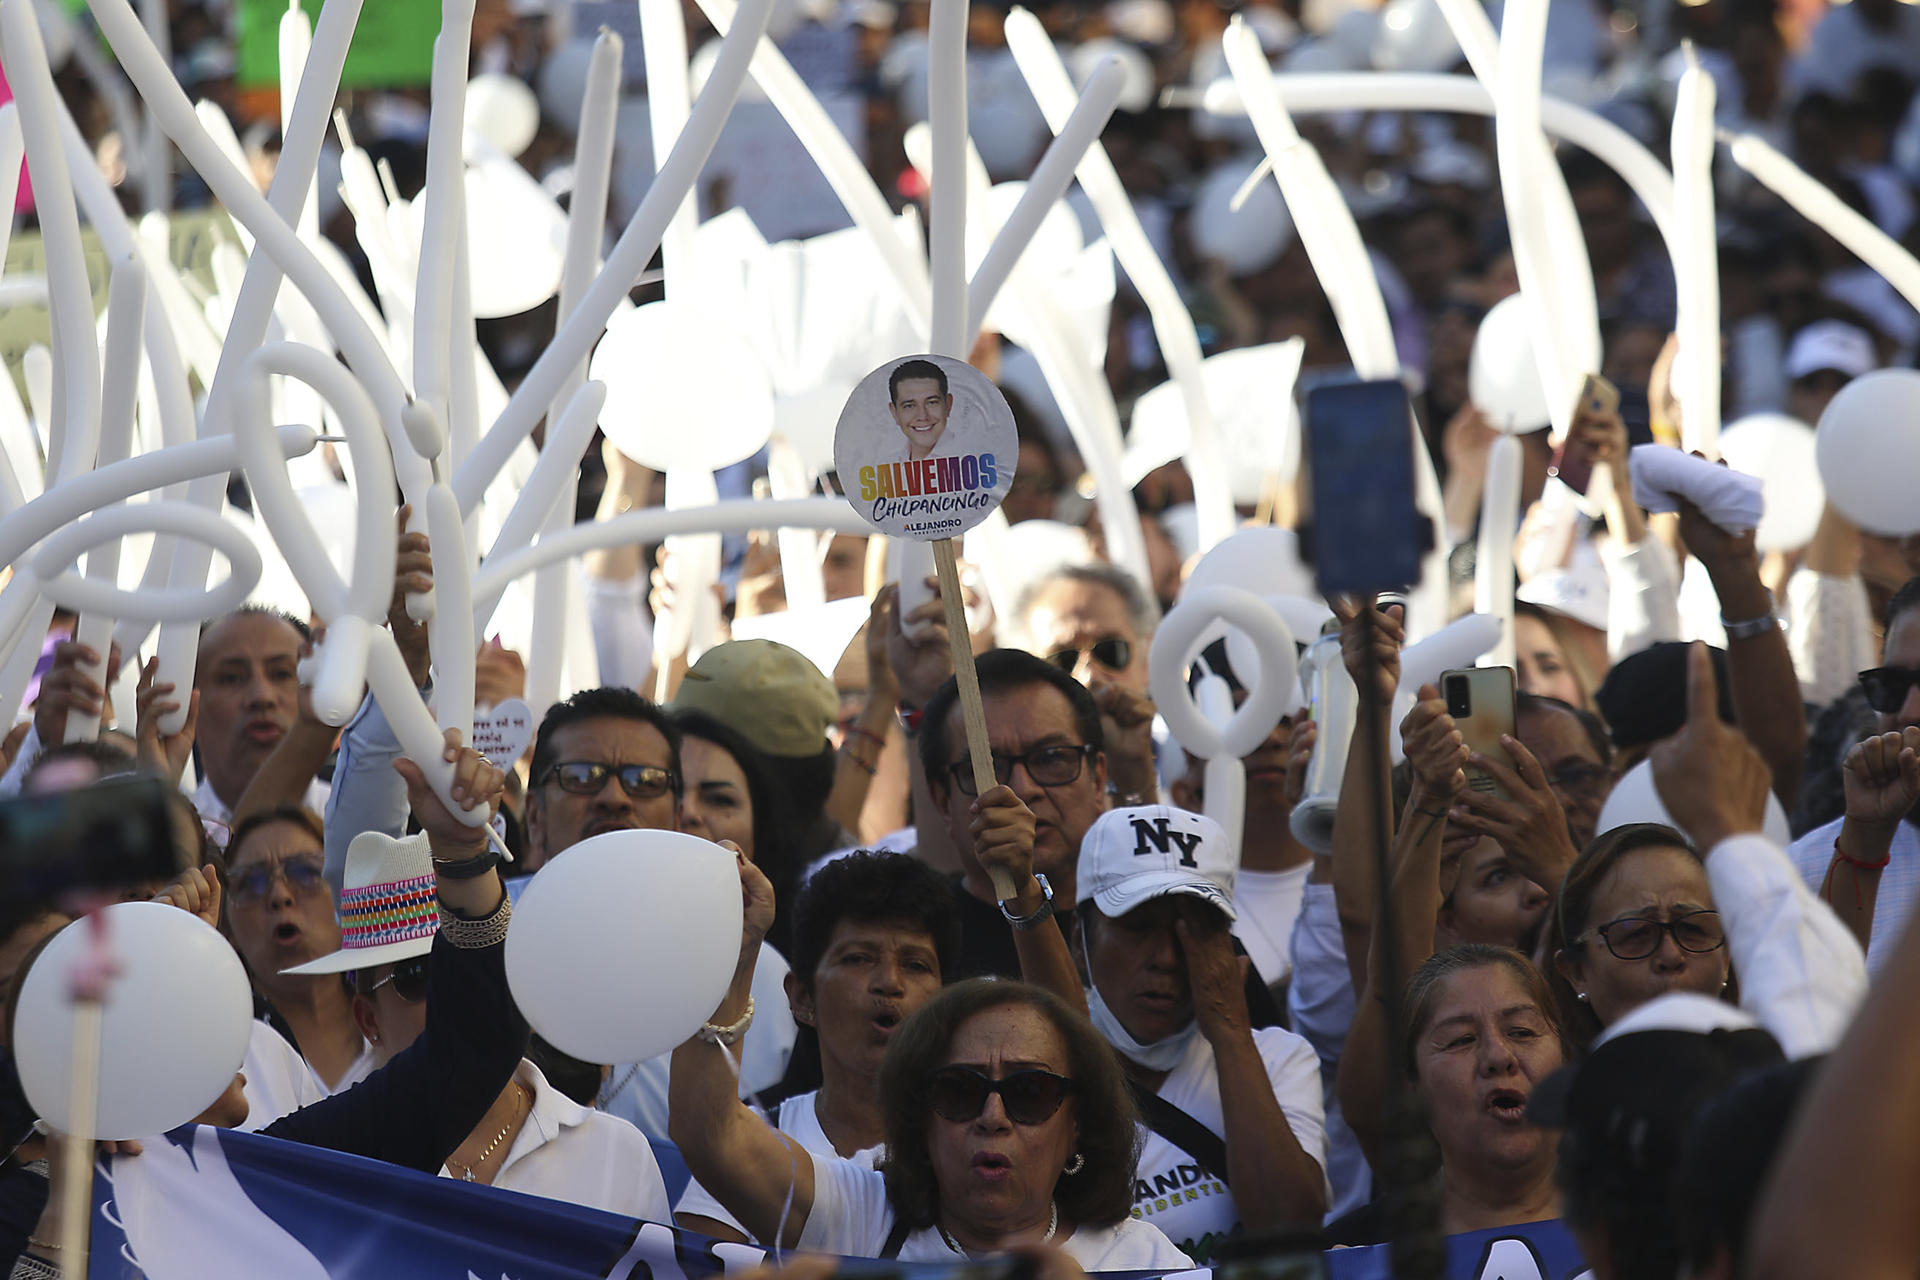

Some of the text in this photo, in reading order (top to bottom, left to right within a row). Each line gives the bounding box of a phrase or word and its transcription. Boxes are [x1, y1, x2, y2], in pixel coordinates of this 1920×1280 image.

[859, 453, 998, 501] SALVEMOS
[904, 518, 962, 533] ALEJANDRO
[1130, 818, 1202, 869] NY
